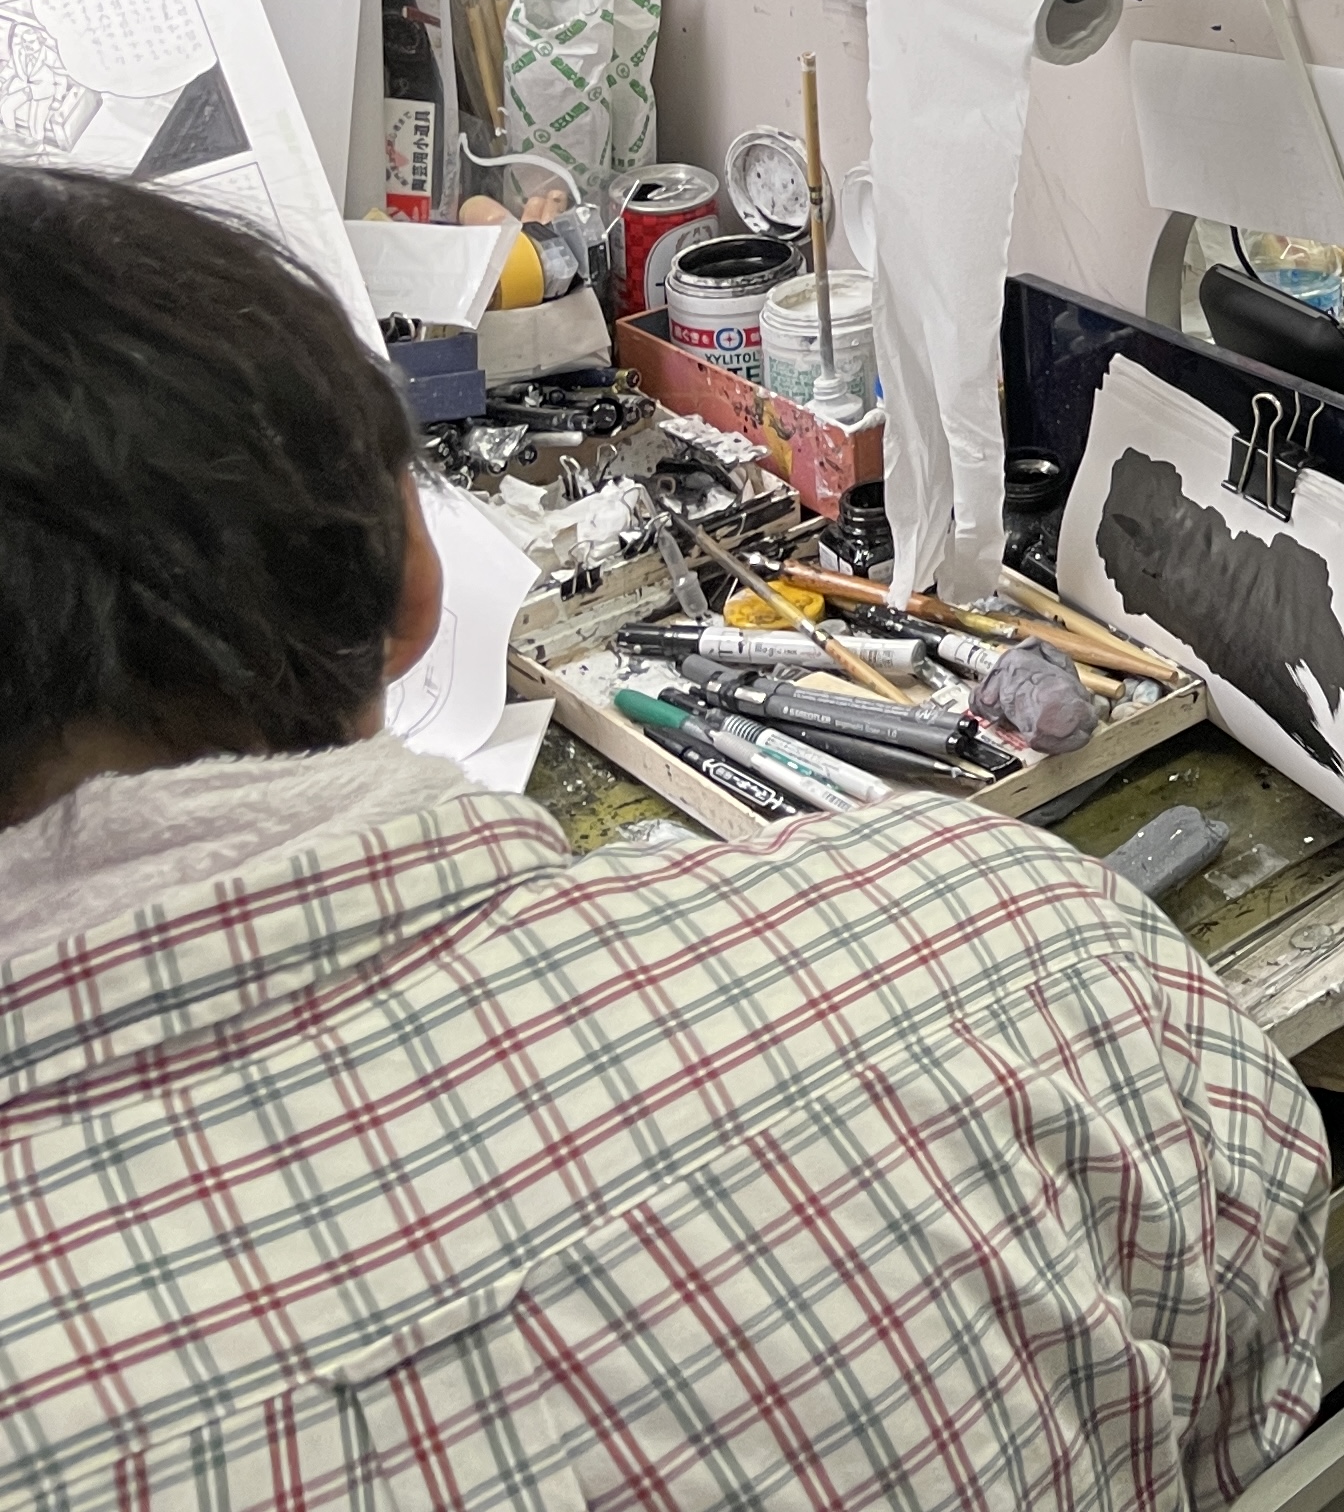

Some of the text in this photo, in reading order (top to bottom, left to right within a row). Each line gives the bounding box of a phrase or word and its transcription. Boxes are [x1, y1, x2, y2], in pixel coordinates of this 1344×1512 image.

[411, 111, 431, 192] 陶芸用小道具
[704, 352, 760, 367] XYLITOL
